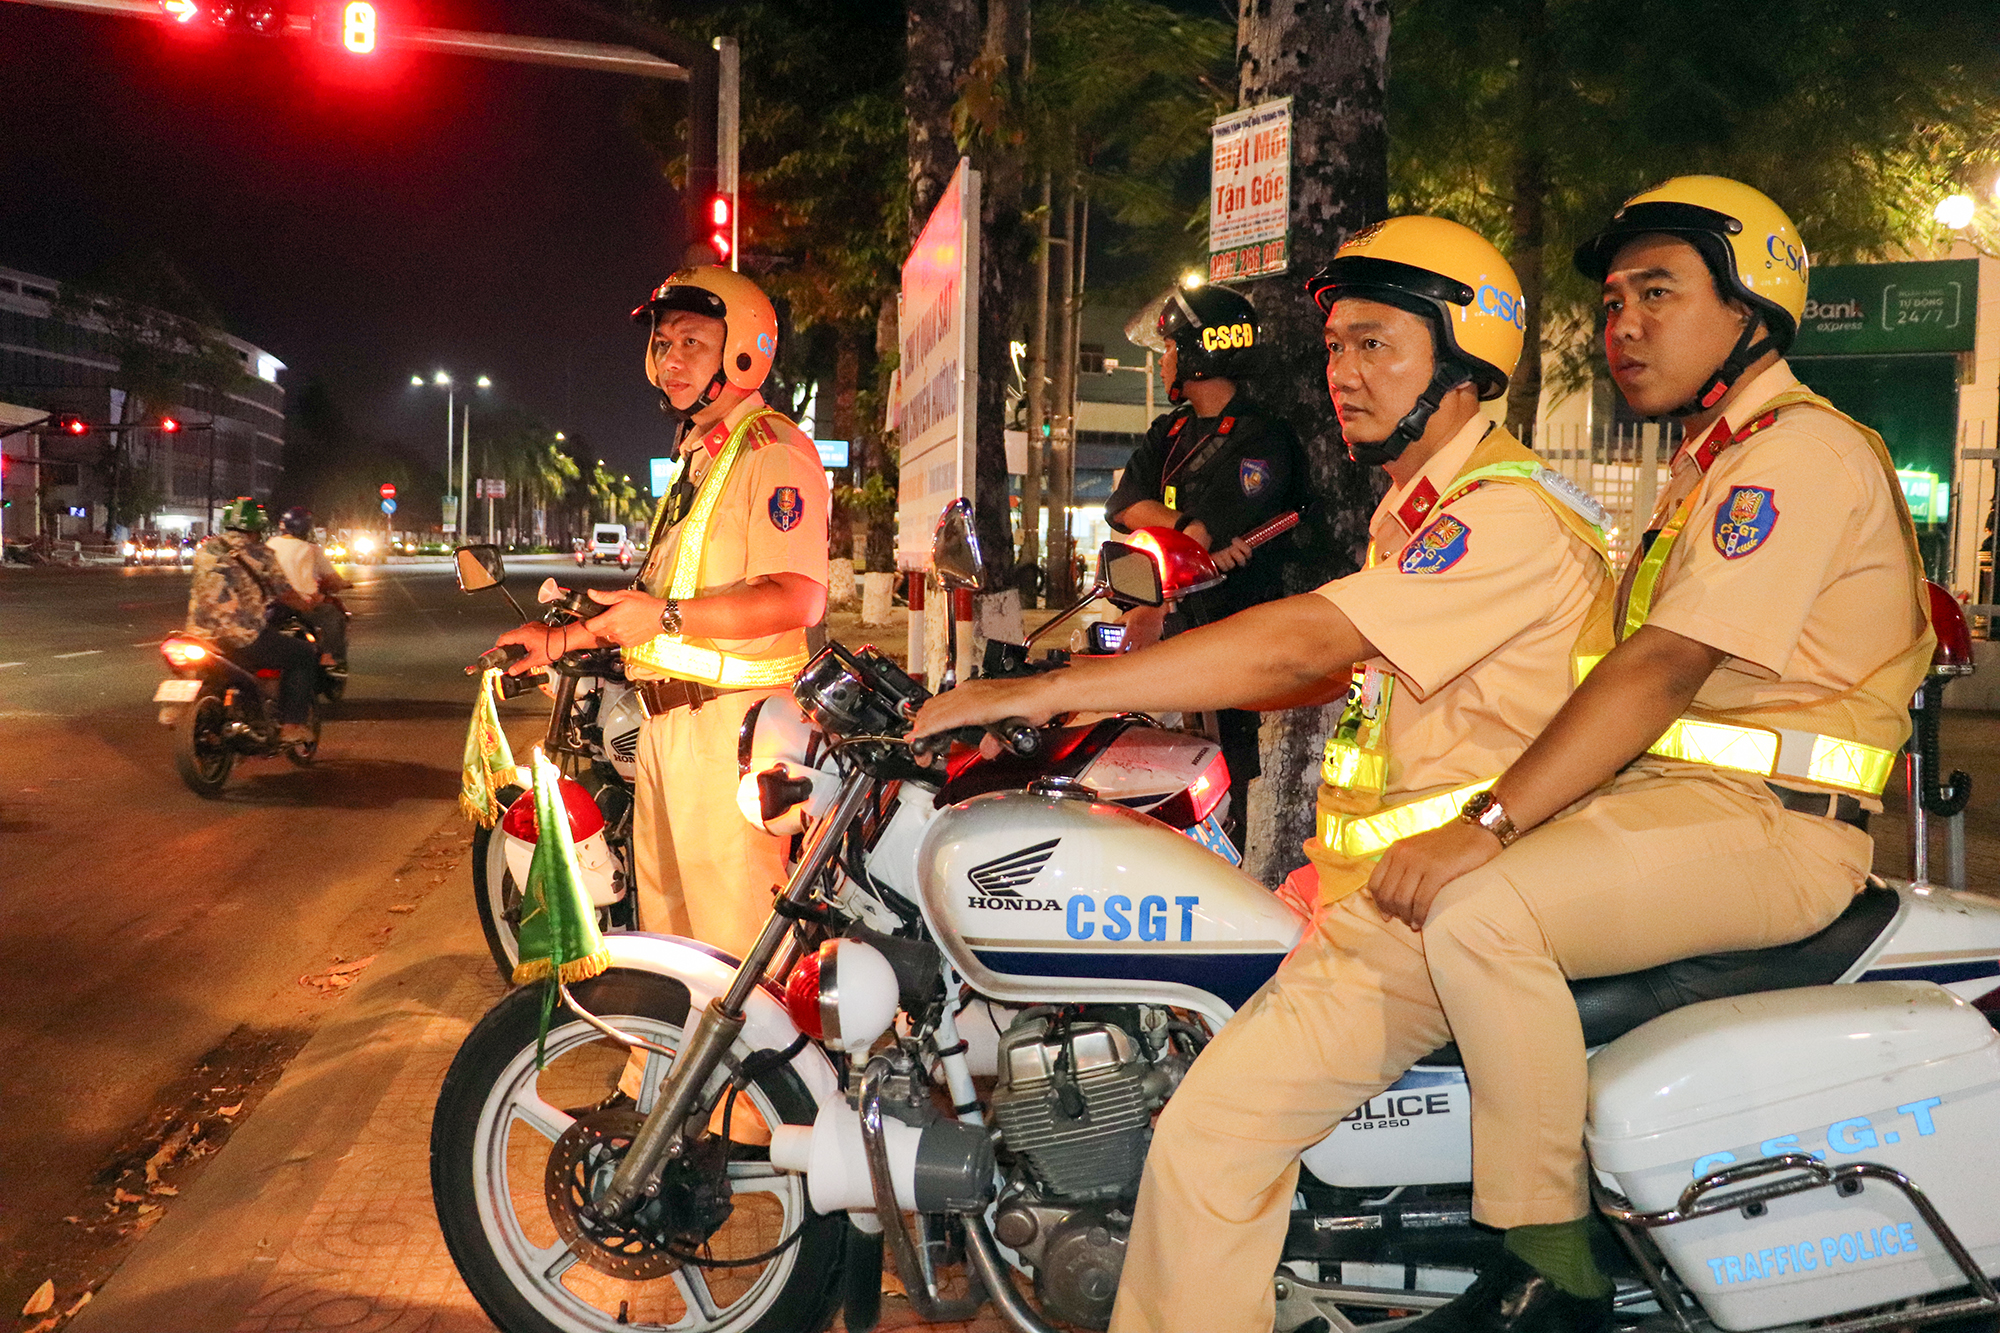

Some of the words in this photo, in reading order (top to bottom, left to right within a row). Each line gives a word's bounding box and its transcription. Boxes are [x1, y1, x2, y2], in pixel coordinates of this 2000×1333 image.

[343, 0, 377, 53] 8
[1216, 182, 1246, 220] Tận
[1251, 167, 1284, 207] Gốc
[1817, 322, 1863, 332] express
[968, 896, 1062, 911] HONDA
[1066, 894, 1199, 942] CSGT
[1352, 1122, 1374, 1131] CB
[1378, 1118, 1410, 1129] 250
[1707, 1241, 1817, 1285] TRAFFIC
[1821, 1222, 1918, 1266] POLICE
